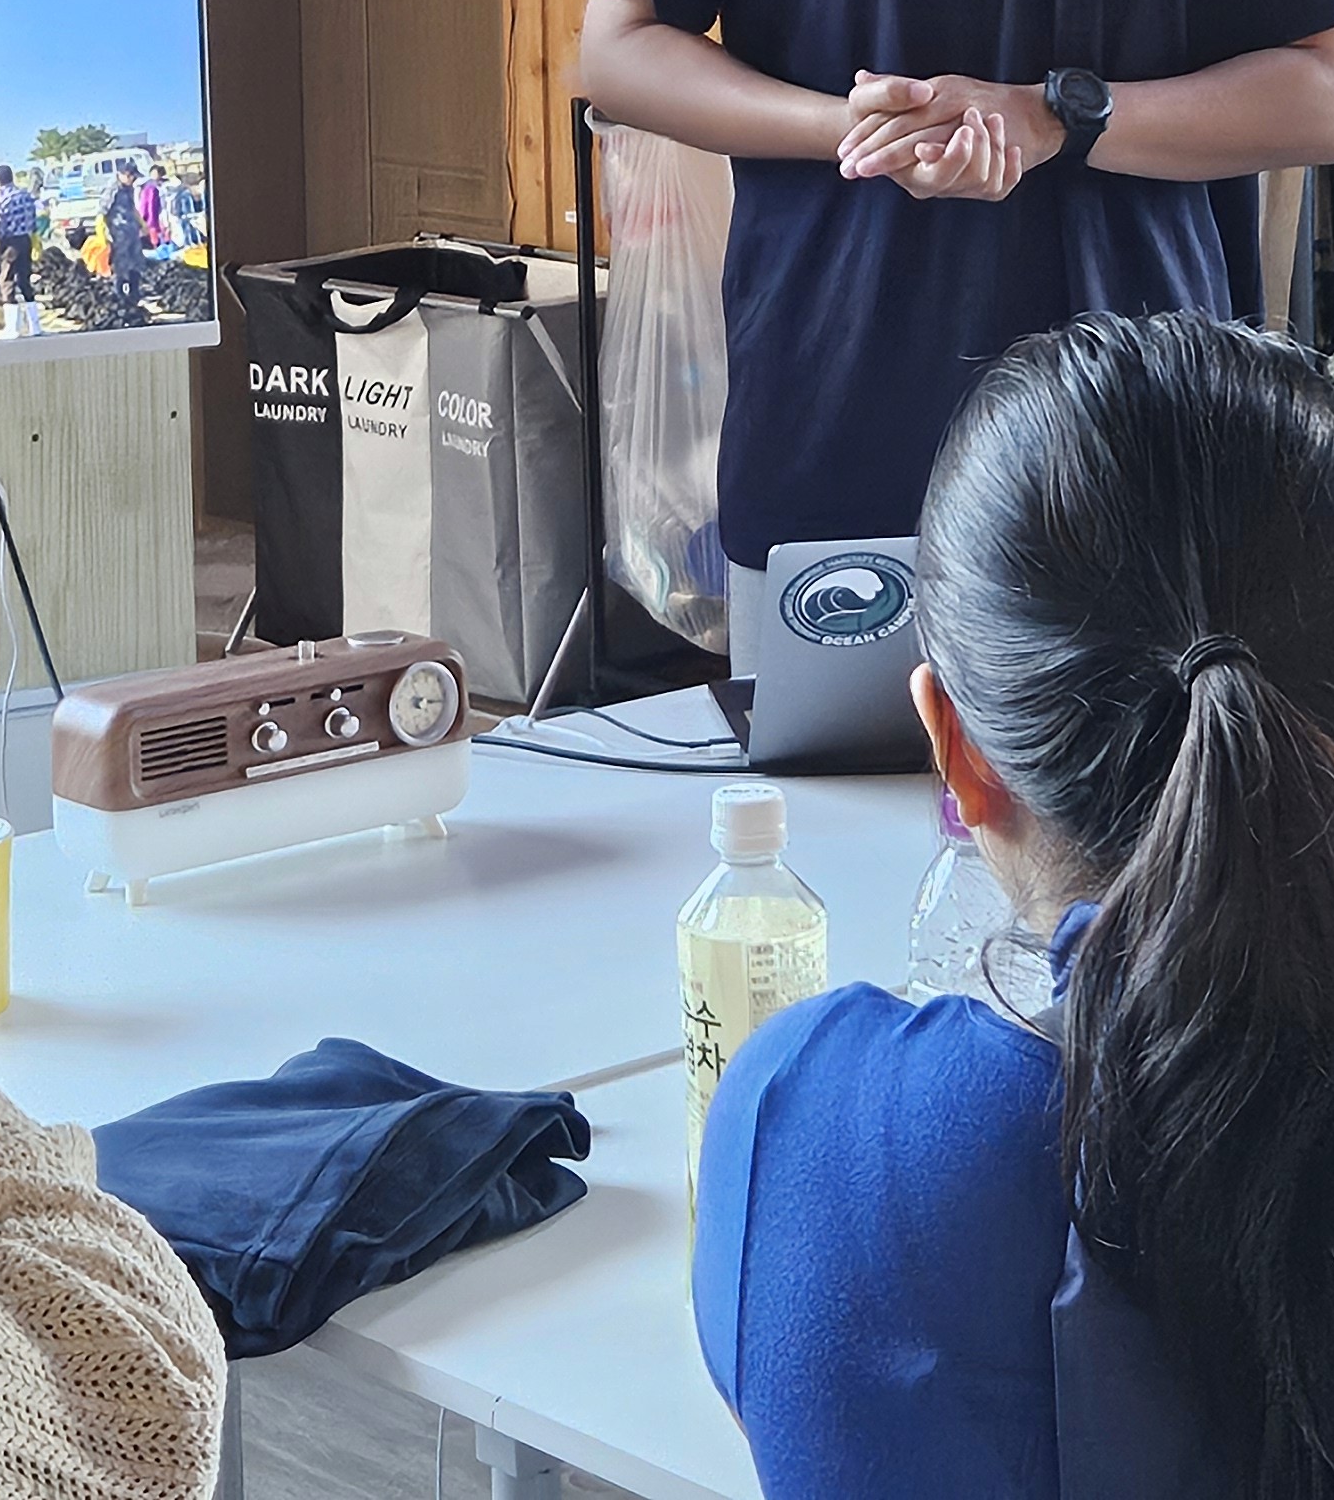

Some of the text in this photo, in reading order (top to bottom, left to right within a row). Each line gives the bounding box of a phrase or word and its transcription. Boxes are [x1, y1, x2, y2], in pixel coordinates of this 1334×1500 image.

[249, 363, 330, 397] DARK
[344, 375, 413, 410] LIGHT
[254, 402, 327, 423] LAUNDRY
[437, 390, 493, 429] COLOR
[348, 415, 408, 439] LAUNDRY
[441, 430, 492, 458] LAUNDRY
[821, 634, 876, 646] OCEAN
